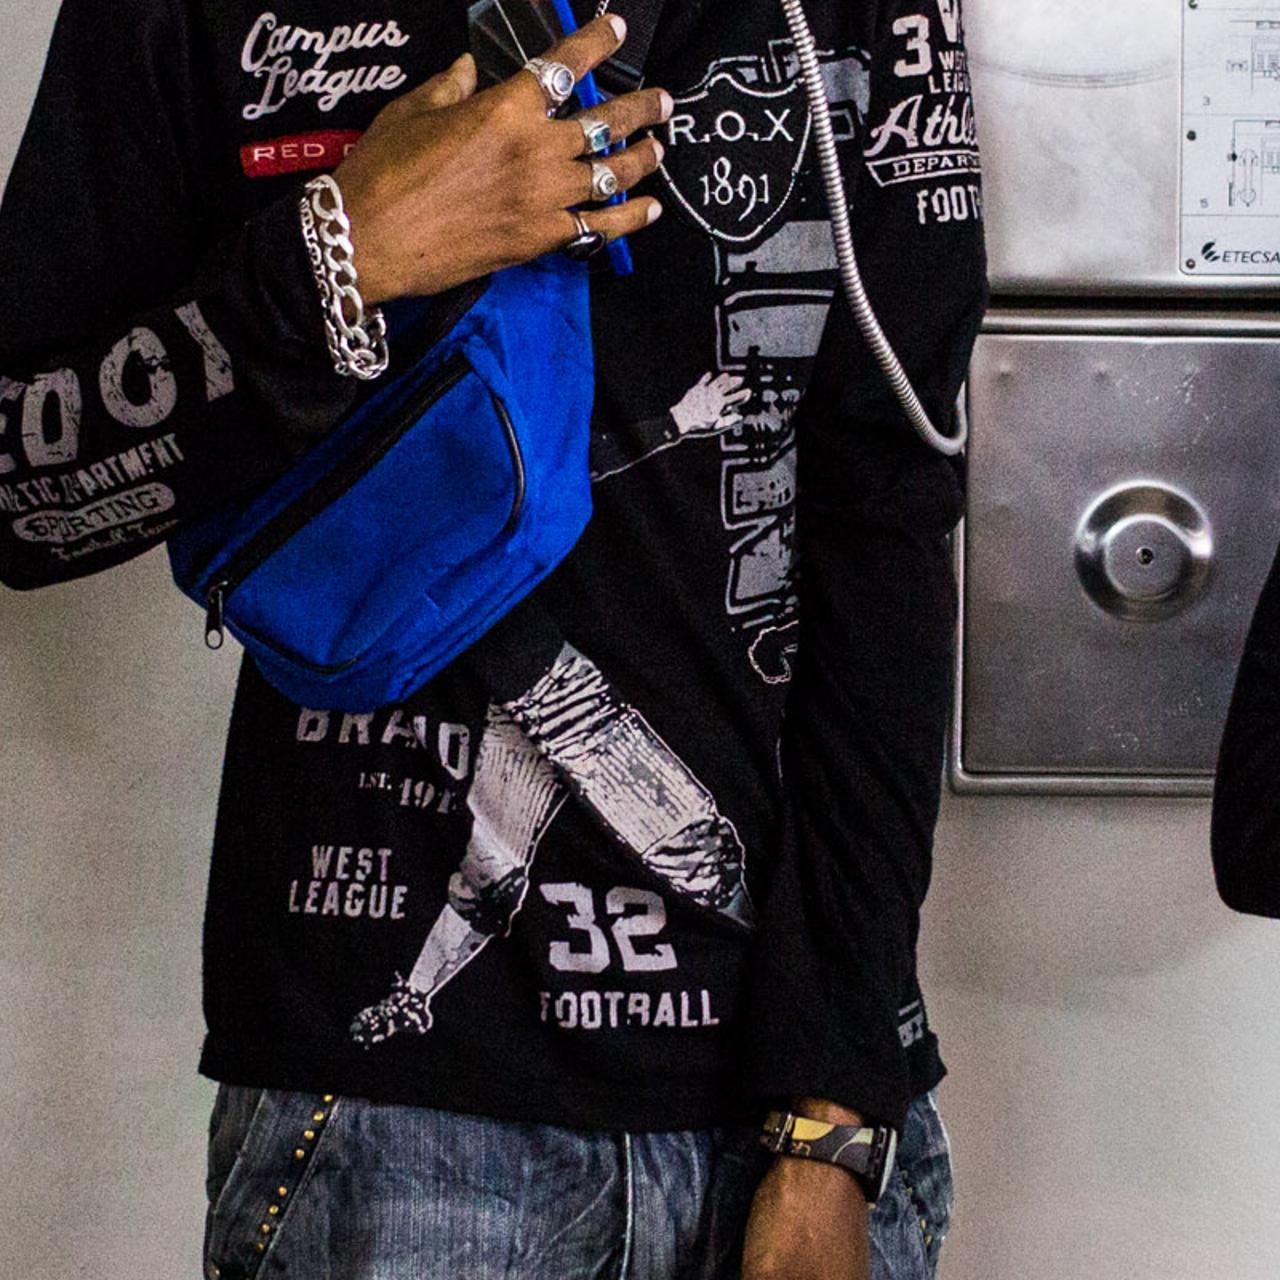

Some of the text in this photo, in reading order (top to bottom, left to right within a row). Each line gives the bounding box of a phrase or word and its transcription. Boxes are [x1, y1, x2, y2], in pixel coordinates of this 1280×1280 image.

[240, 11, 410, 72] Campus
[242, 56, 407, 119] League
[253, 143, 325, 162] RED
[700, 156, 769, 222] 1891
[311, 845, 393, 883] WEST
[288, 879, 408, 920] LEAGUE
[539, 881, 679, 974] 32
[539, 989, 720, 1030] FOOTBALL
